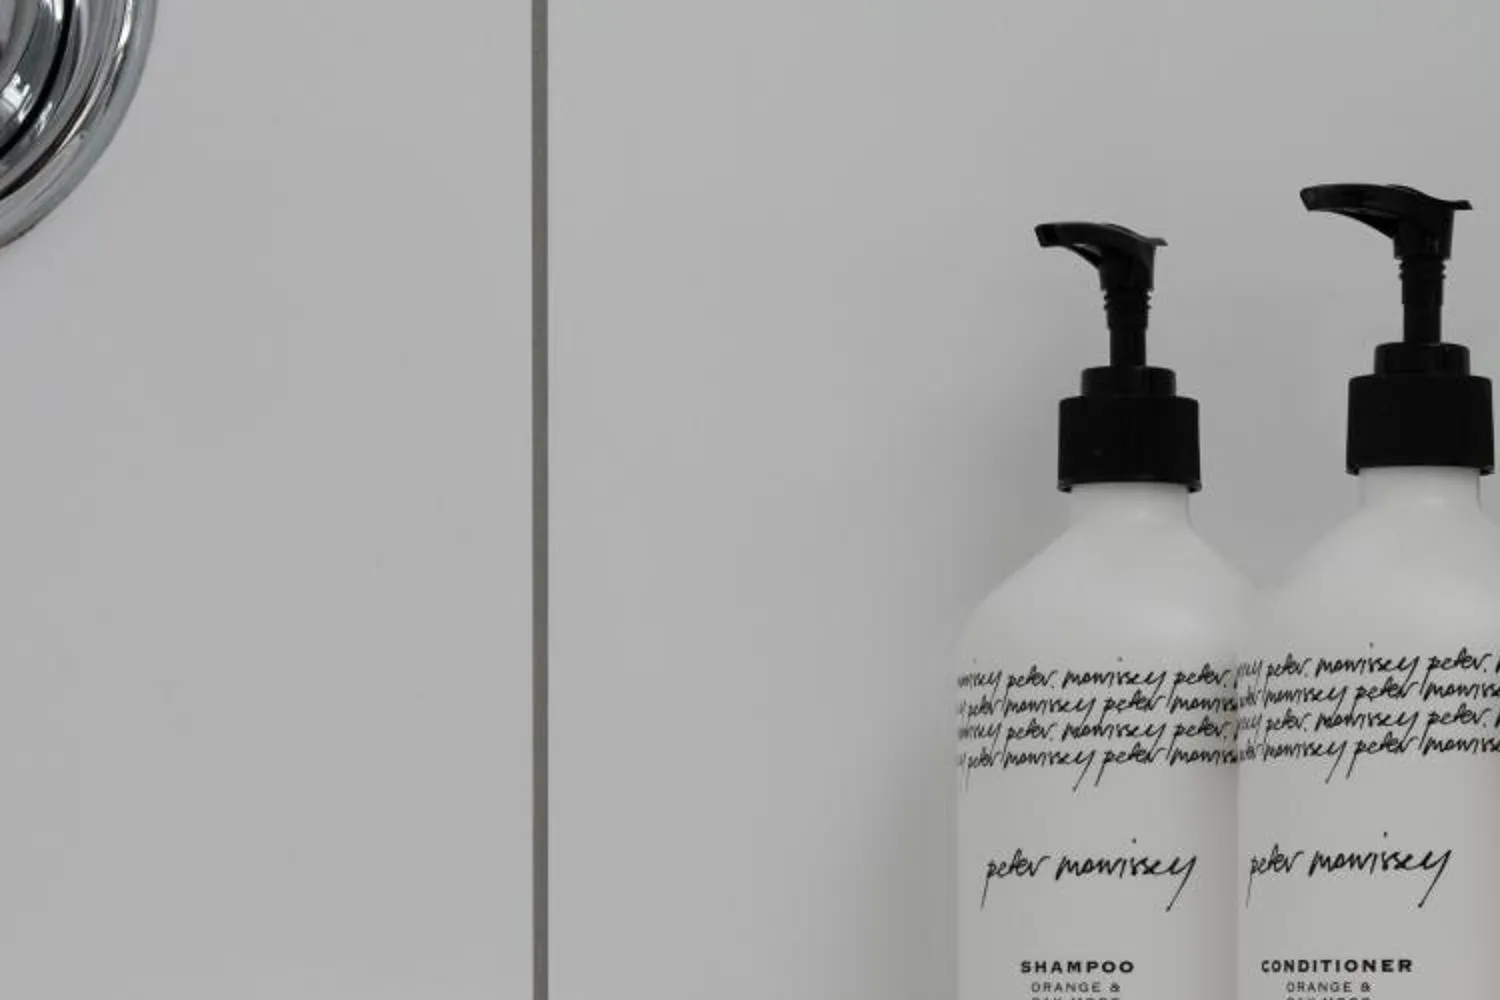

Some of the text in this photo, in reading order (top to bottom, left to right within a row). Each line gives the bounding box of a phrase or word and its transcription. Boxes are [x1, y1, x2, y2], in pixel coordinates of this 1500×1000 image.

[981, 837, 1197, 912] peter morrissey
[1245, 831, 1452, 908] peter morrissey
[1021, 960, 1134, 974] SHAMPOO
[1261, 958, 1413, 973] CONDITIONER
[1031, 981, 1120, 993] ORANGE &
[1286, 981, 1371, 993] ORANGE &
